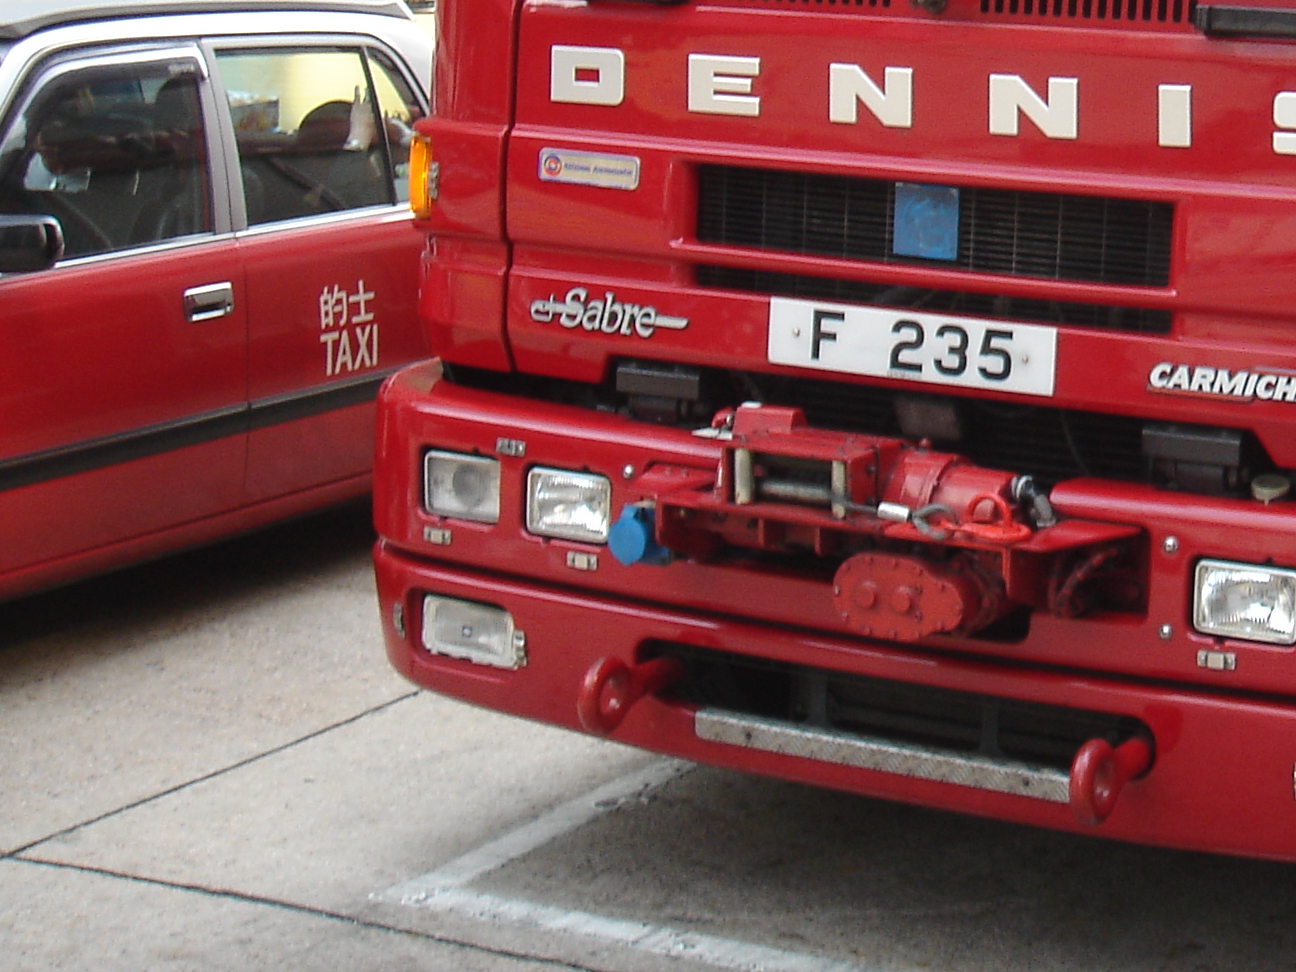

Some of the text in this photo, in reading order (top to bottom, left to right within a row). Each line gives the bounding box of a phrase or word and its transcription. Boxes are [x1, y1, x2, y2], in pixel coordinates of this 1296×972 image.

[320, 279, 375, 330] 的士
[558, 286, 658, 339] Sabre
[320, 323, 379, 377] TAXI
[810, 308, 1014, 383] F 235
